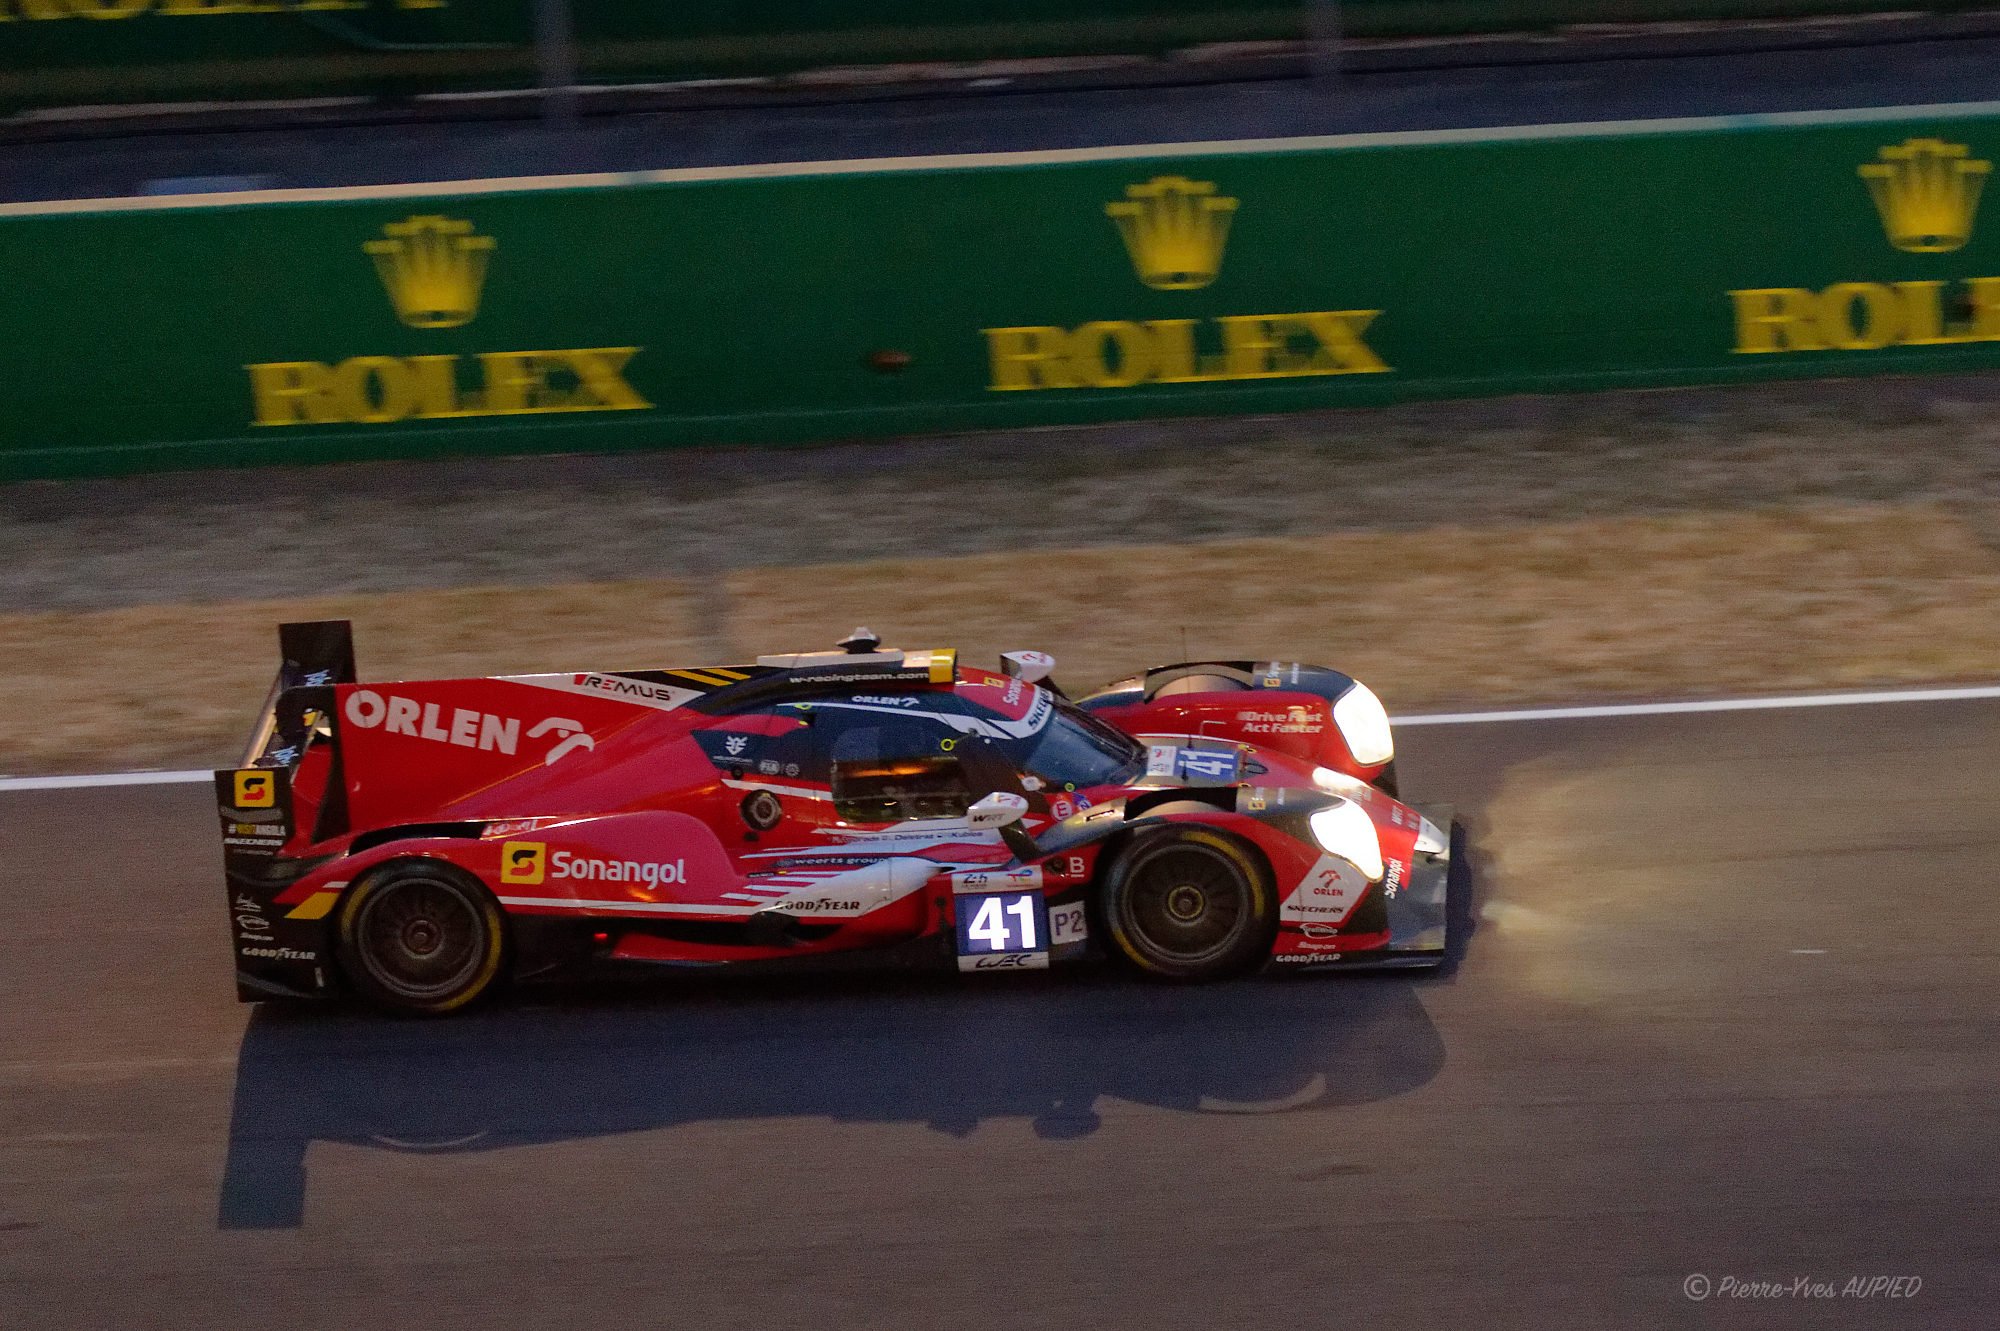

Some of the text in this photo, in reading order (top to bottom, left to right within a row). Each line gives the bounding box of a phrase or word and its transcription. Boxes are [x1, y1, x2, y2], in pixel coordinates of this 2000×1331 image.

[980, 309, 1396, 391] ROLEX
[242, 347, 655, 427] ROLEX
[583, 674, 671, 701] REMUS
[852, 695, 900, 706] ORLEN
[345, 690, 520, 756] ORLEN
[1248, 711, 1286, 722] Drive
[1242, 723, 1323, 734] Act Faster
[1056, 802, 1069, 817] E
[551, 852, 686, 890] Sonangol
[795, 858, 843, 866] weerts
[1069, 857, 1085, 877] B
[1384, 857, 1406, 899] Sonangol
[1313, 888, 1344, 897] ORLEN
[1287, 905, 1344, 913] SKECHERS
[968, 895, 1037, 951] 41
[1055, 909, 1083, 936] P2
